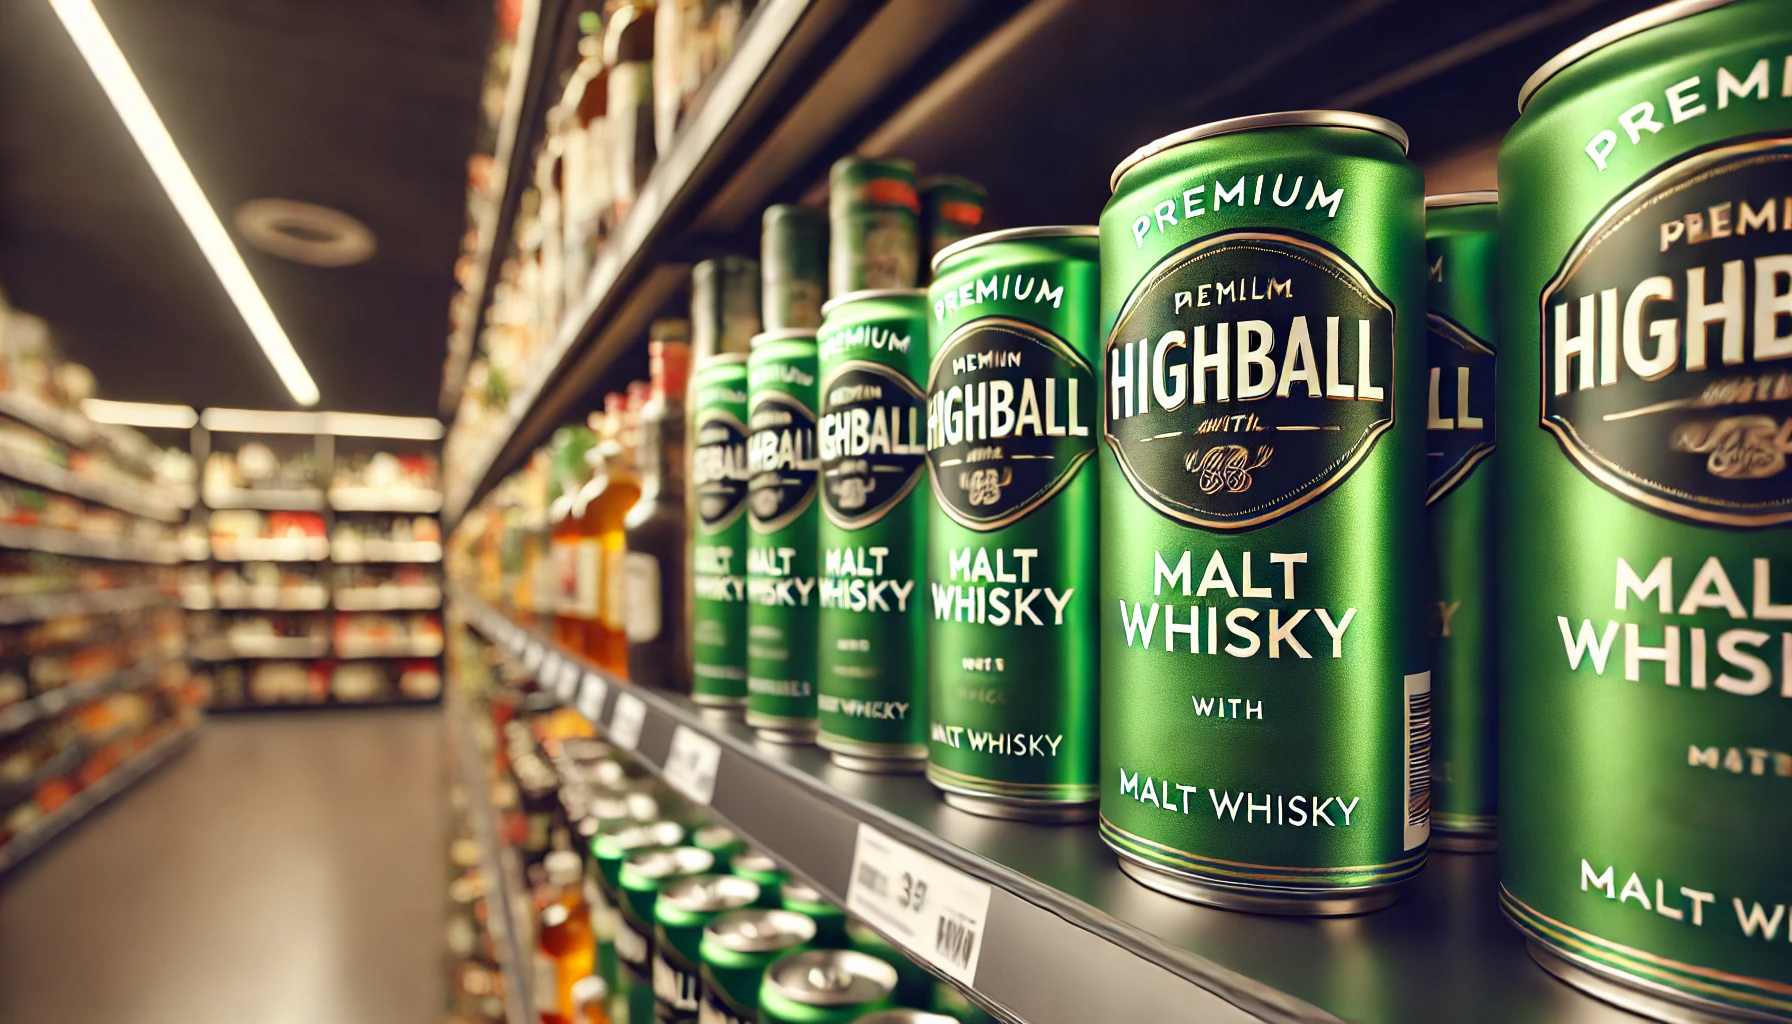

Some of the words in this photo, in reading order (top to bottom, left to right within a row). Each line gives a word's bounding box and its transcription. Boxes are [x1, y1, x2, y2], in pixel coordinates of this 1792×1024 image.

[1131, 173, 1346, 249] PREMIUM
[933, 274, 1065, 325] PREMIUM
[1111, 315, 1386, 420] HIGHBALL
[926, 377, 1089, 452] HIGHBALL
[825, 546, 890, 577] MALT
[949, 546, 1039, 584] MALT
[1153, 549, 1309, 600] MALT
[818, 577, 915, 613] WHISKY
[931, 581, 1075, 627] WHISKY
[1119, 599, 1358, 659] WHISKY
[1556, 615, 1792, 698] WHIS
[1191, 694, 1264, 720] WITH
[967, 727, 1063, 758] WHISKY
[1119, 766, 1197, 814] MALT
[1208, 787, 1361, 828] WHISKY
[1580, 858, 1715, 926] MALT
